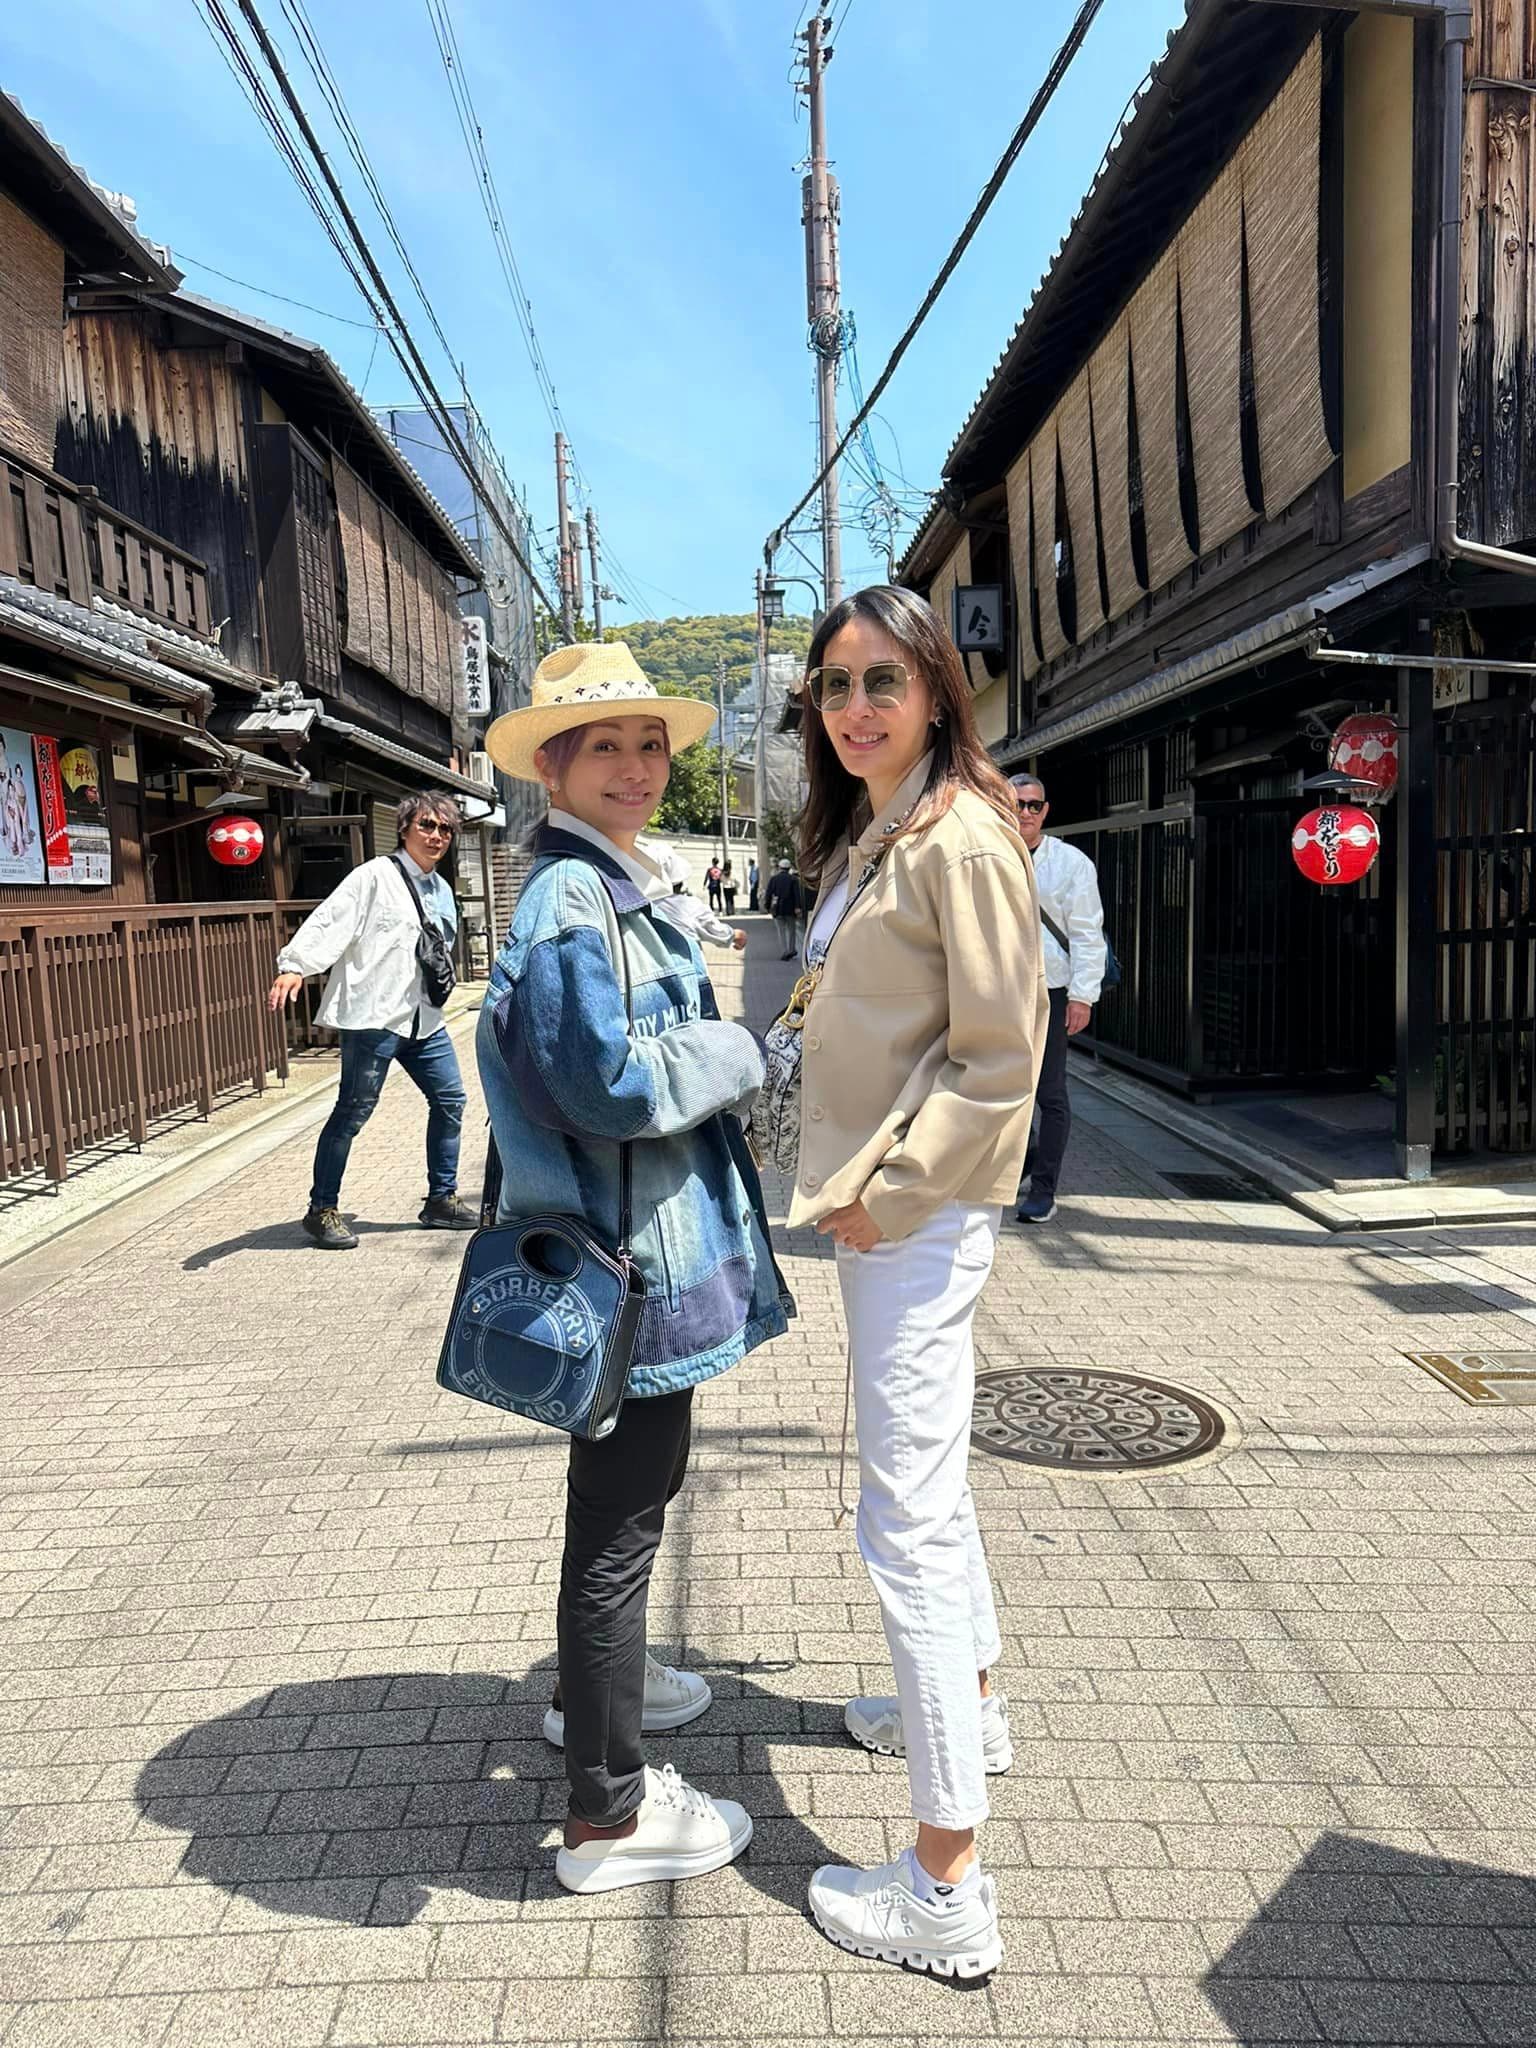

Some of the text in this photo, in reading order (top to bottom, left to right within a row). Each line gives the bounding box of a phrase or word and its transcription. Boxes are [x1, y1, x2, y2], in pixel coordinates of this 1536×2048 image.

[1318, 811, 1340, 879] 都をどり
[472, 1277, 589, 1347] BURBERRY
